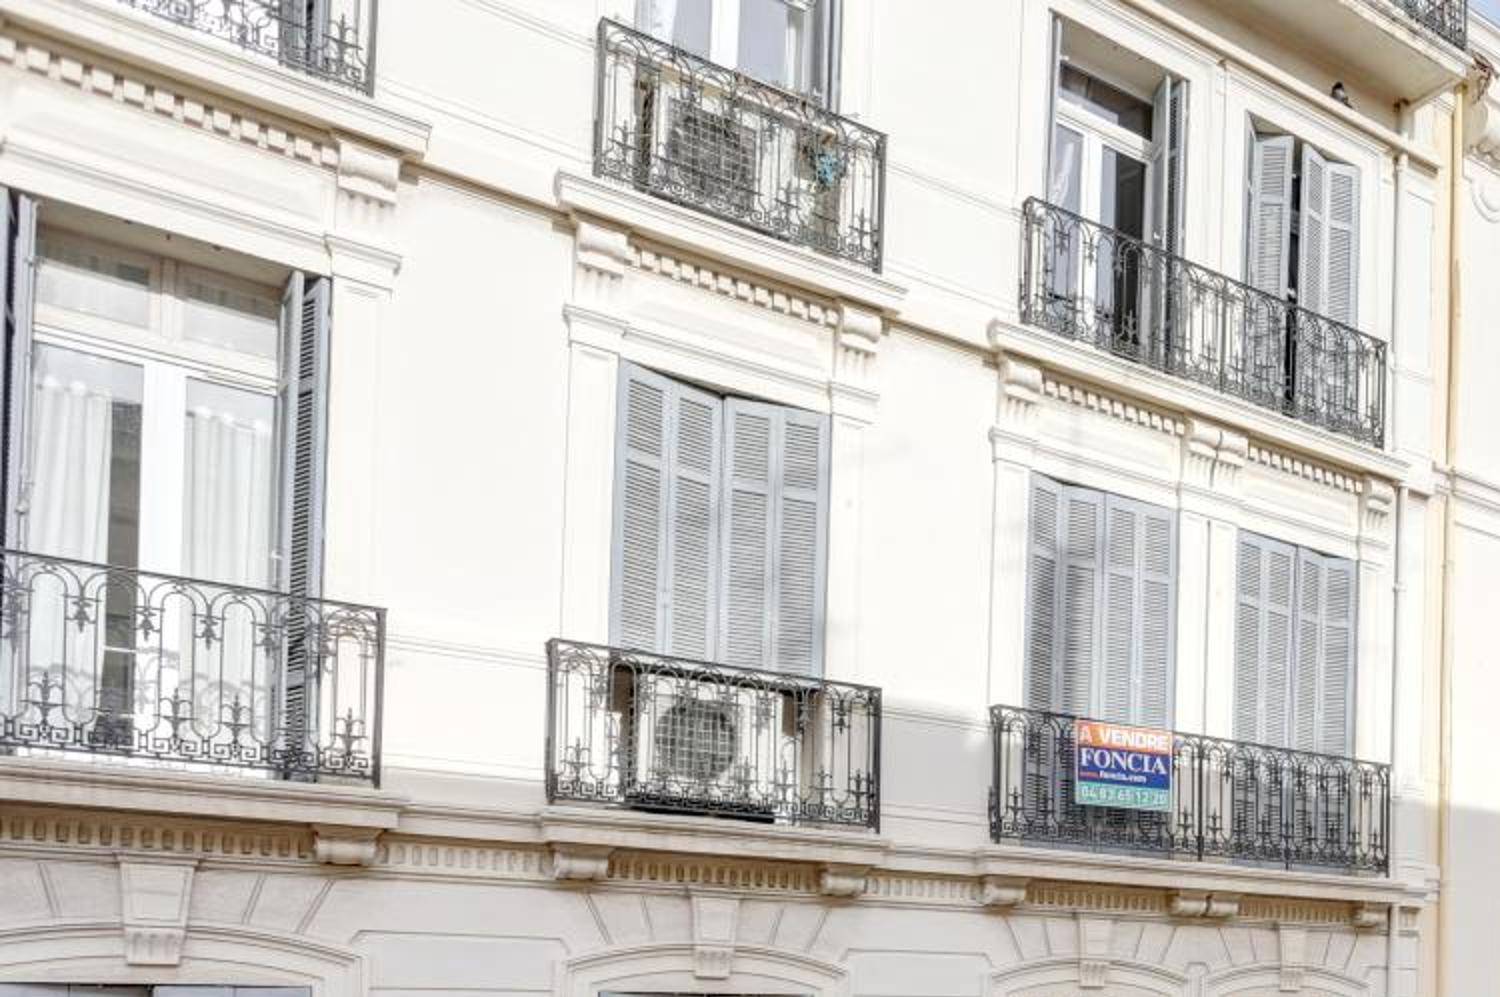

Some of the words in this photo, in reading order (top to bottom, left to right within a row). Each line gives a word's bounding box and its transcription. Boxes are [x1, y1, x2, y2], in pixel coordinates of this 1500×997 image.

[1081, 725, 1092, 743] A
[1100, 727, 1169, 751] VENDRE
[1081, 747, 1167, 774] FONCIA
